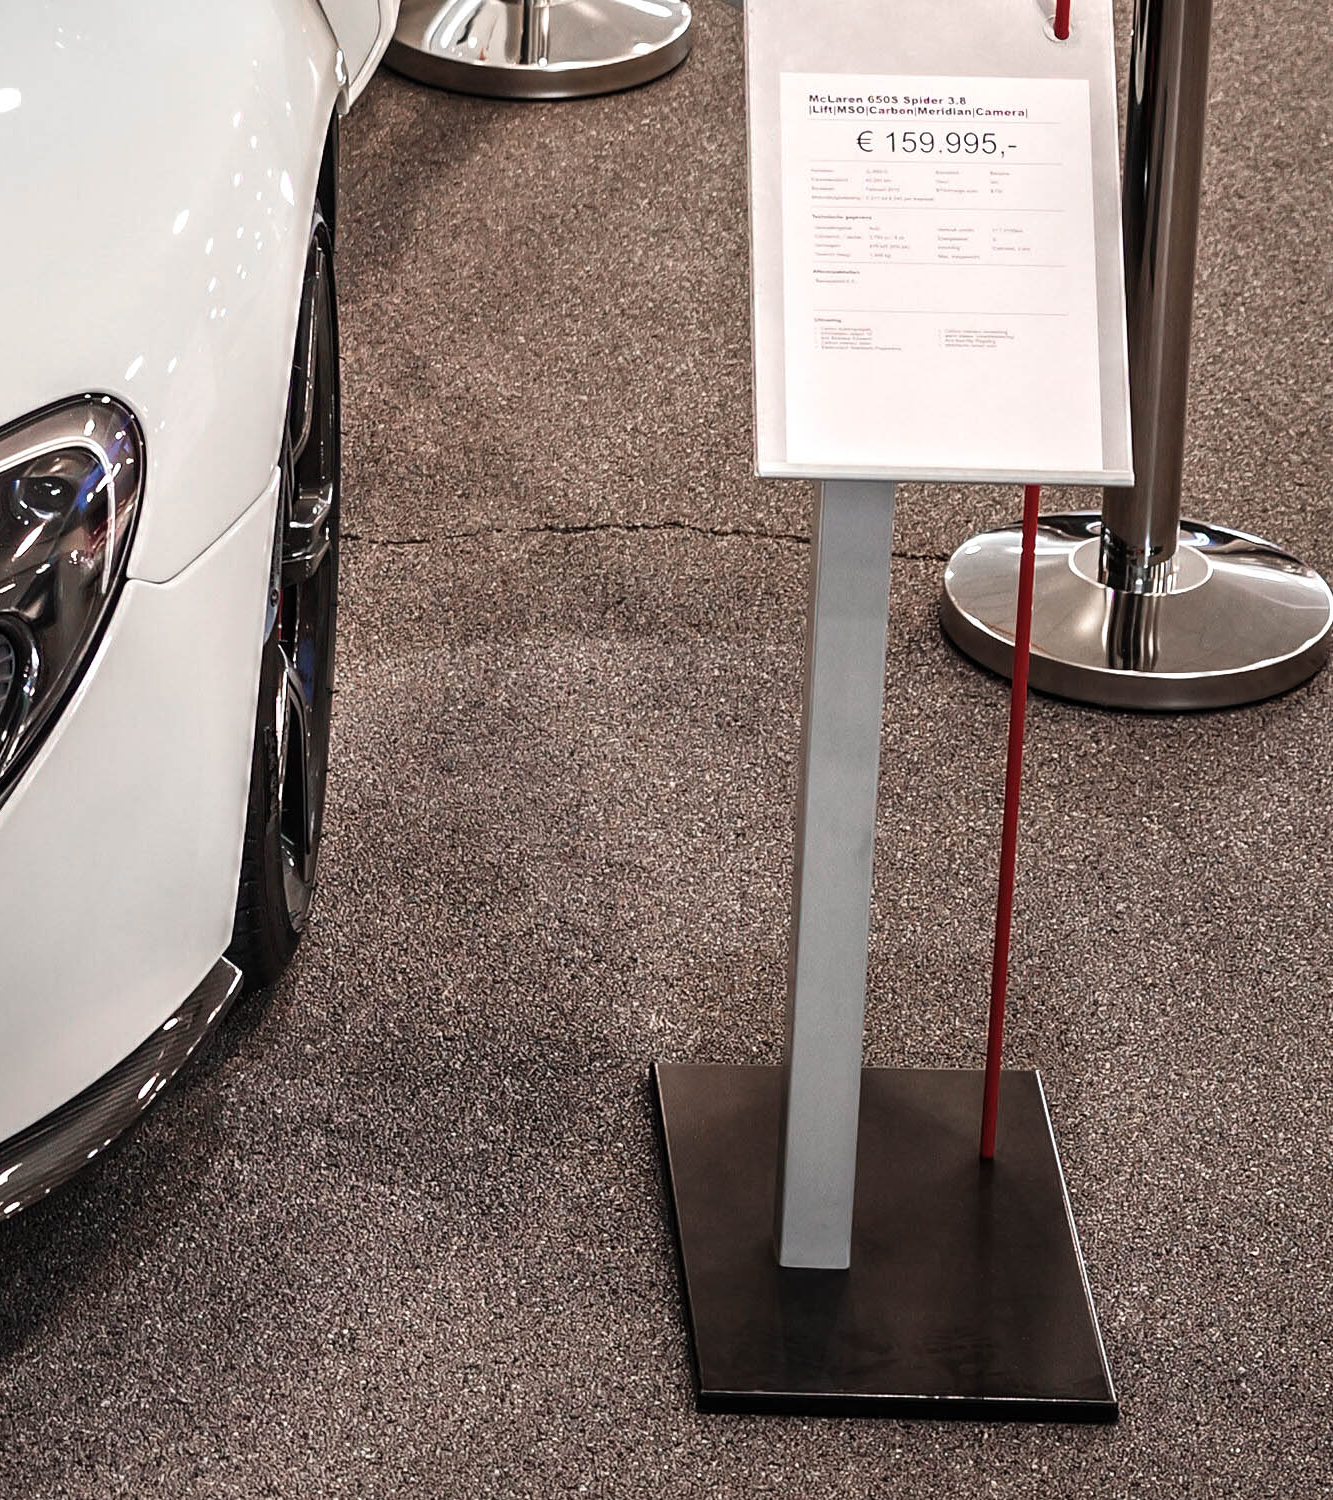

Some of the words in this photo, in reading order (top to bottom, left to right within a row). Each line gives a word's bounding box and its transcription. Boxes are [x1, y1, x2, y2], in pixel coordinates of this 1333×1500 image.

[808, 95, 863, 104] McLaren
[867, 96, 899, 104] 650S
[903, 96, 944, 106] Spider
[947, 97, 967, 105] 3.8
[856, 130, 874, 153] €
[885, 131, 1017, 158] 159.995,-
